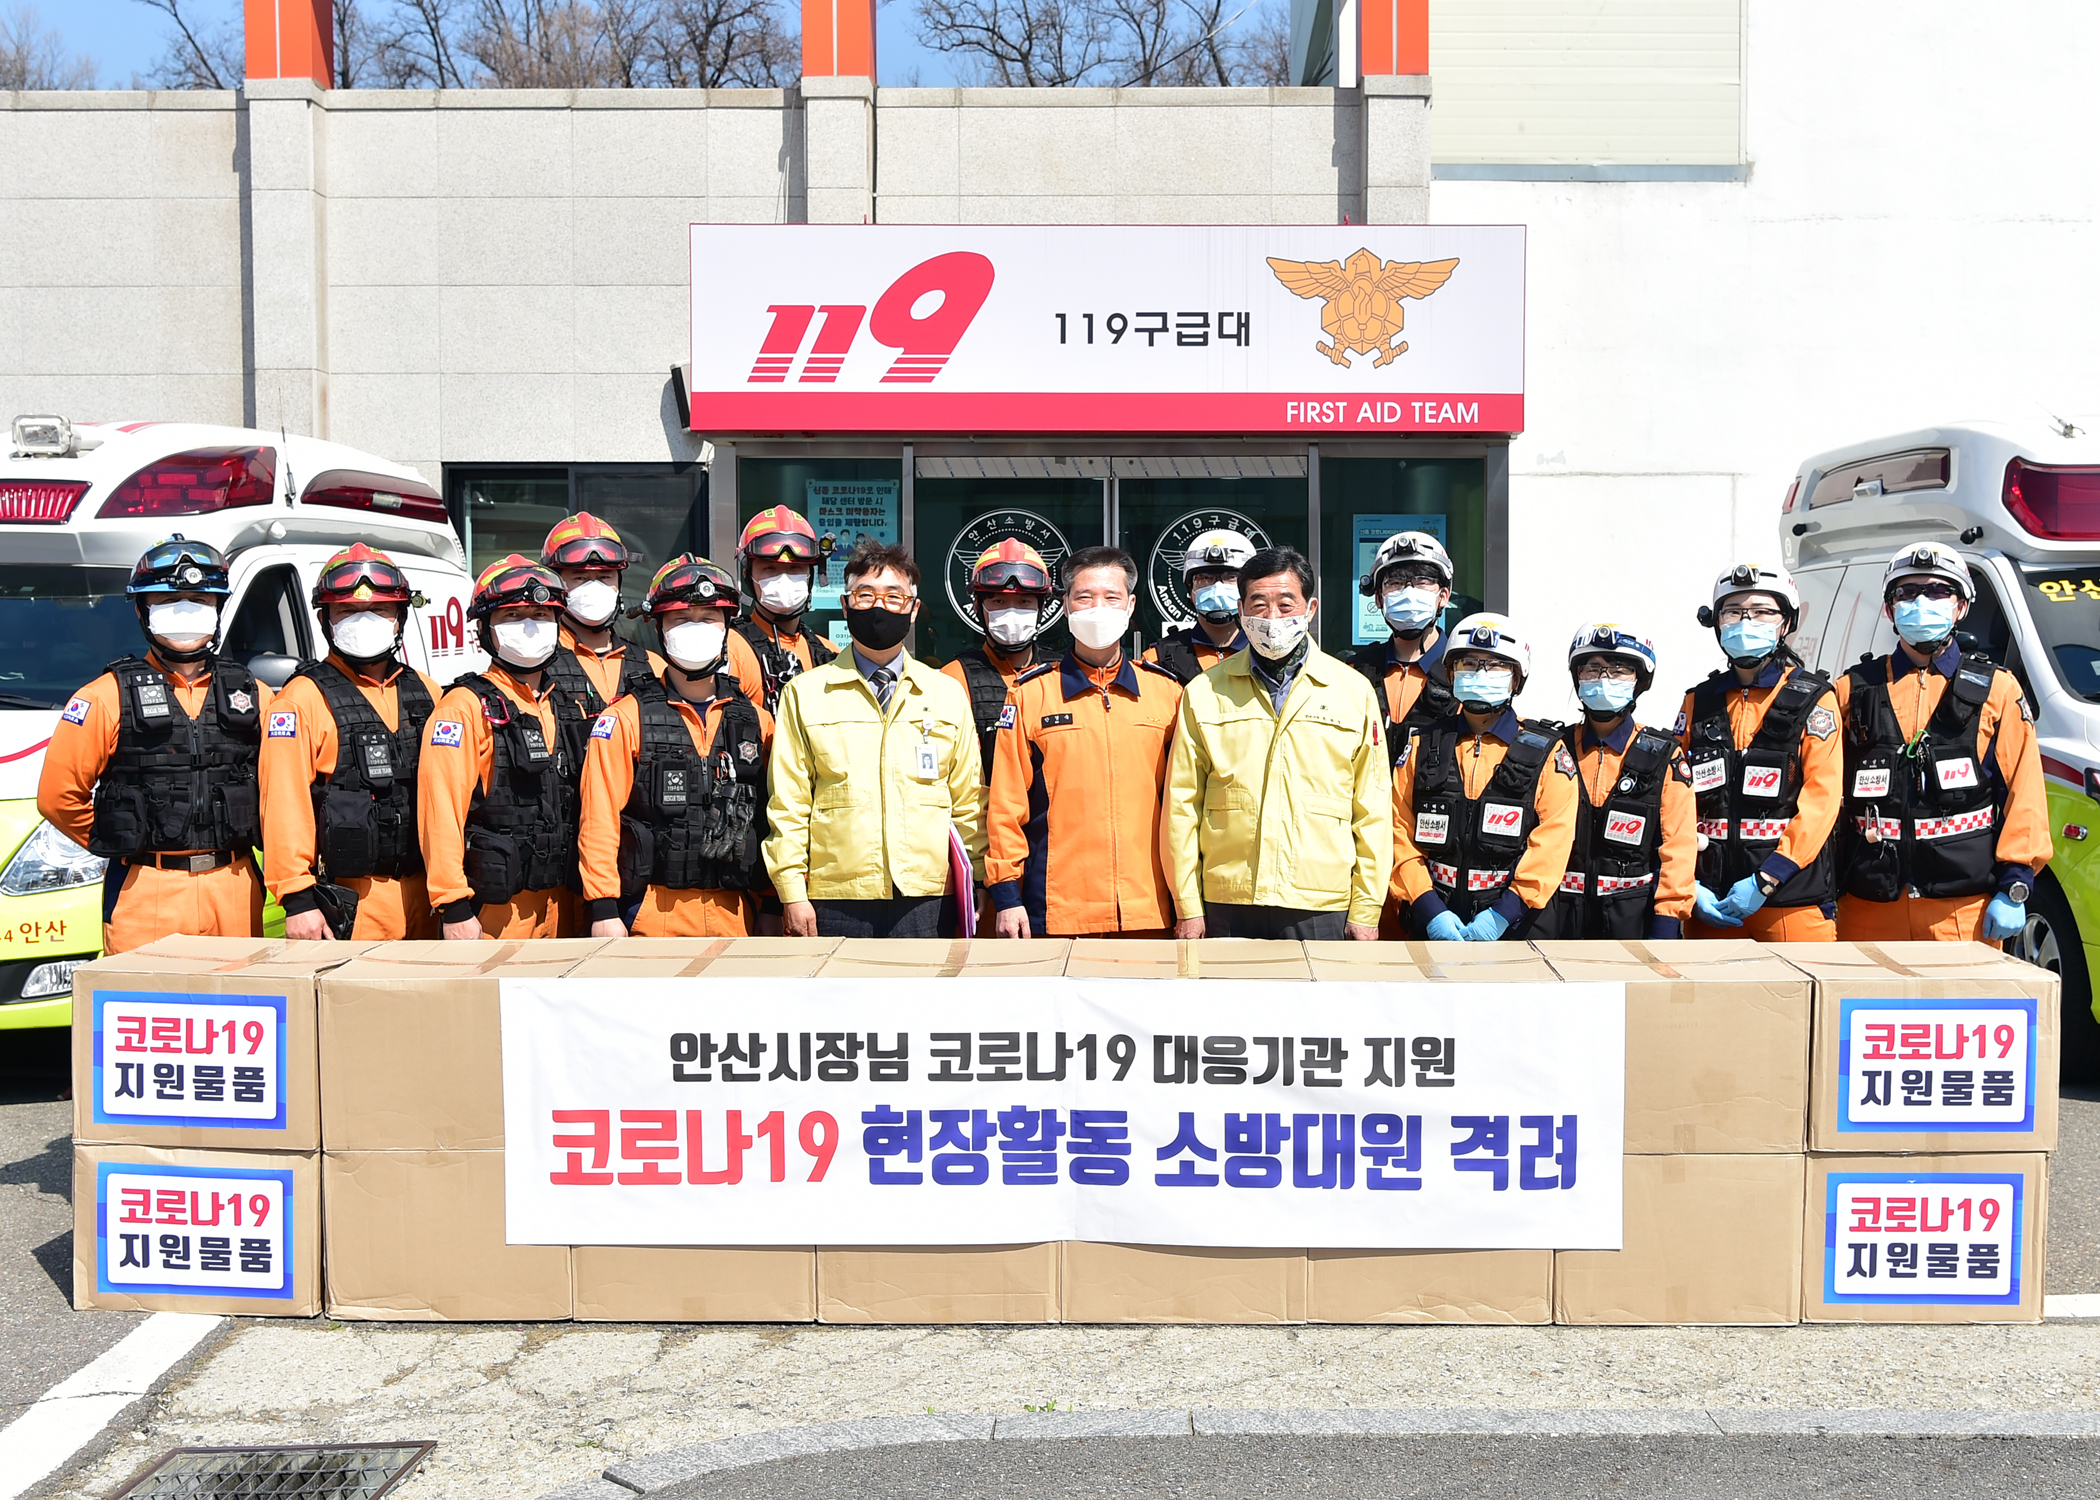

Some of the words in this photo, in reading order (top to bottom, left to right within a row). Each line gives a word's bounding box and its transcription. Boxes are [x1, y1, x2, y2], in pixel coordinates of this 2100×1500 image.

[747, 251, 995, 383] 119
[1054, 311, 1251, 348] 119구급대
[1286, 401, 1348, 424] FIRST
[1356, 401, 1402, 424] AID
[1410, 401, 1479, 424] TEAM
[821, 497, 837, 506] 해당
[840, 497, 855, 506] 센터
[857, 497, 874, 506] 방문
[875, 497, 883, 505] 시
[832, 486, 874, 496] 코로나19로
[876, 486, 892, 495] 인해
[819, 507, 843, 516] 마스크
[846, 507, 886, 517] 미착용자는
[968, 516, 1051, 542] 안산소방서
[1172, 515, 1257, 541] 119구급대
[1157, 585, 1182, 619] Ansan
[427, 596, 464, 658] 119
[1696, 764, 1723, 780] 안산소방서
[1747, 772, 1779, 790] 119
[1859, 775, 1888, 785] 안산소방서
[1419, 818, 1447, 831] 안산소방서
[1486, 810, 1520, 828] 119
[1608, 820, 1643, 836] 119
[19, 919, 68, 944] 안산
[115, 1015, 265, 1056] 코로나19
[1862, 1023, 2015, 1060] 코로나19
[669, 1032, 909, 1082] 안산시장님
[927, 1031, 1137, 1082] 코로나19
[1152, 1034, 1349, 1088] 대응기관
[1363, 1036, 1456, 1088] 지원
[114, 1062, 266, 1103] 지원물품
[1860, 1069, 2015, 1107] 지원물품
[549, 1109, 840, 1186] 코로나19
[860, 1104, 1132, 1187] 현장활동
[1154, 1111, 1423, 1191] 소방대원
[1450, 1114, 1578, 1192] 격려
[119, 1187, 271, 1228] 코로나19
[1848, 1196, 2001, 1233] 코로나19
[119, 1233, 273, 1274] 지원물품
[1846, 1242, 2001, 1280] 지원물품
